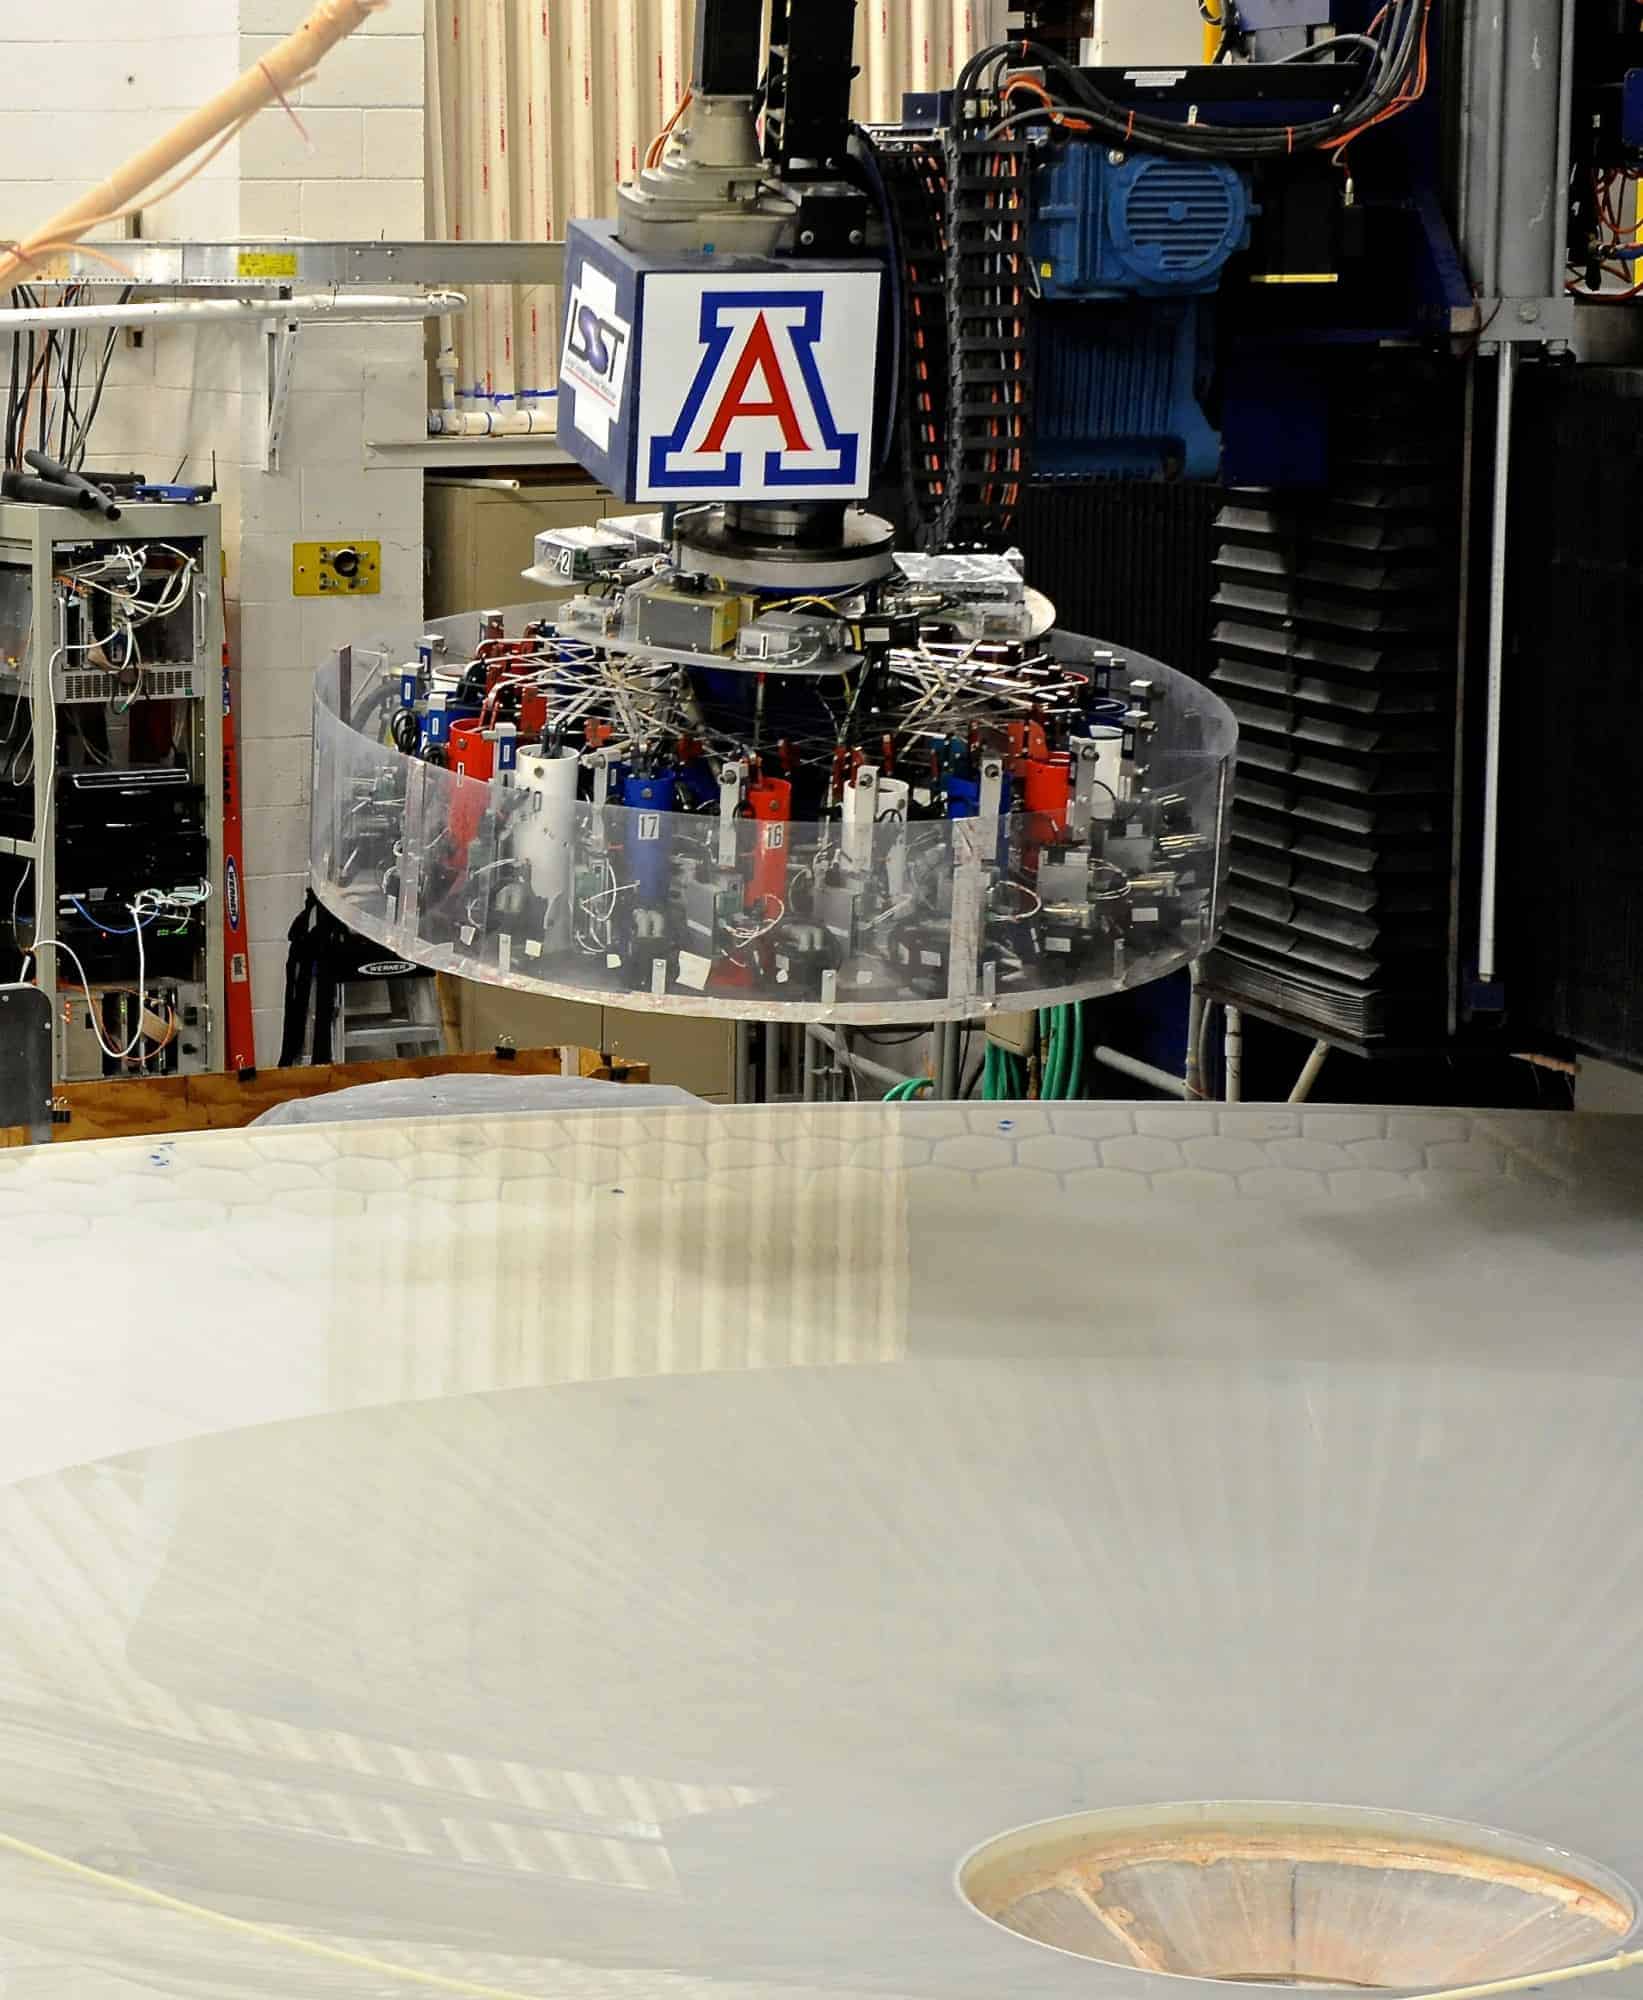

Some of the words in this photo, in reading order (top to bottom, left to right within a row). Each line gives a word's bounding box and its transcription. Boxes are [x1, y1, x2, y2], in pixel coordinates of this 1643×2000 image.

[649, 290, 859, 488] A
[561, 550, 570, 573] 2
[640, 815, 658, 838] 17
[767, 824, 782, 847] 16
